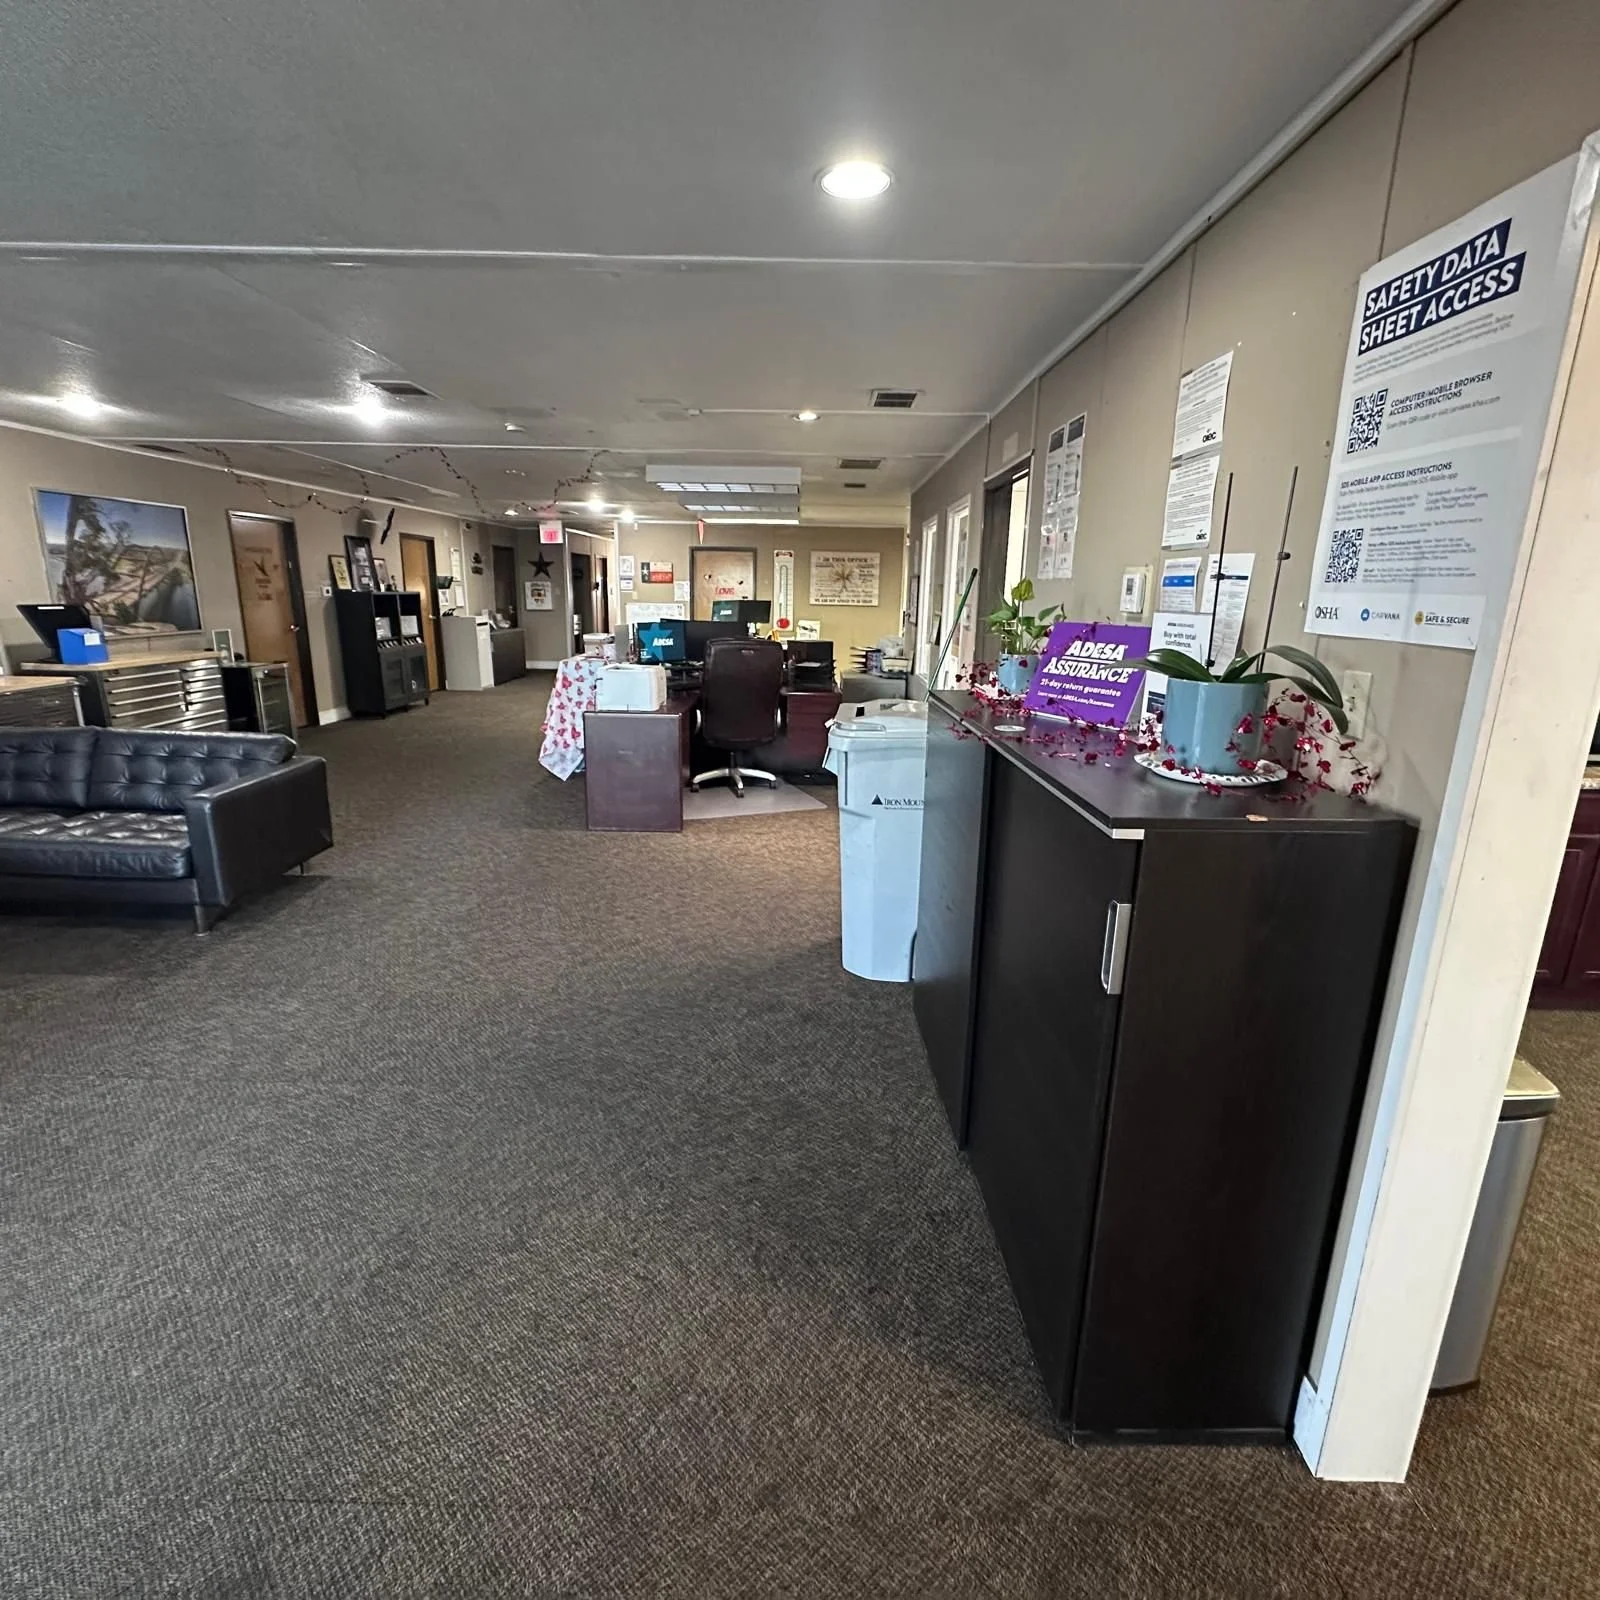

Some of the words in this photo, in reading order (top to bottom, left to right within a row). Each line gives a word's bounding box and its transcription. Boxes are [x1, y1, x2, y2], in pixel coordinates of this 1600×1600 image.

[1365, 260, 1441, 318] SAFETY
[1441, 229, 1500, 282] DATA
[1360, 304, 1422, 351] SHEET
[1422, 262, 1518, 326] ACCESS
[1454, 371, 1493, 390] BROWSER
[1389, 403, 1413, 417] ACCESS
[1413, 389, 1463, 410] INSTRUCTIONS
[1350, 476, 1369, 487] MOBILE
[1369, 475, 1381, 483] APP
[1381, 470, 1405, 481] ACCESS
[1406, 461, 1453, 478] INSTRUCTIONS
[1314, 606, 1339, 620] OSHA
[1425, 615, 1439, 623] SAFE
[1446, 616, 1470, 625] SECURE
[1163, 630, 1173, 639] Buy
[1064, 640, 1126, 661] ADESA
[1042, 657, 1134, 684] ASSURANCE
[1040, 678, 1062, 690] 21-day
[1062, 682, 1084, 692] return
[1084, 686, 1122, 697] guarantee
[884, 798, 901, 806] IRON
